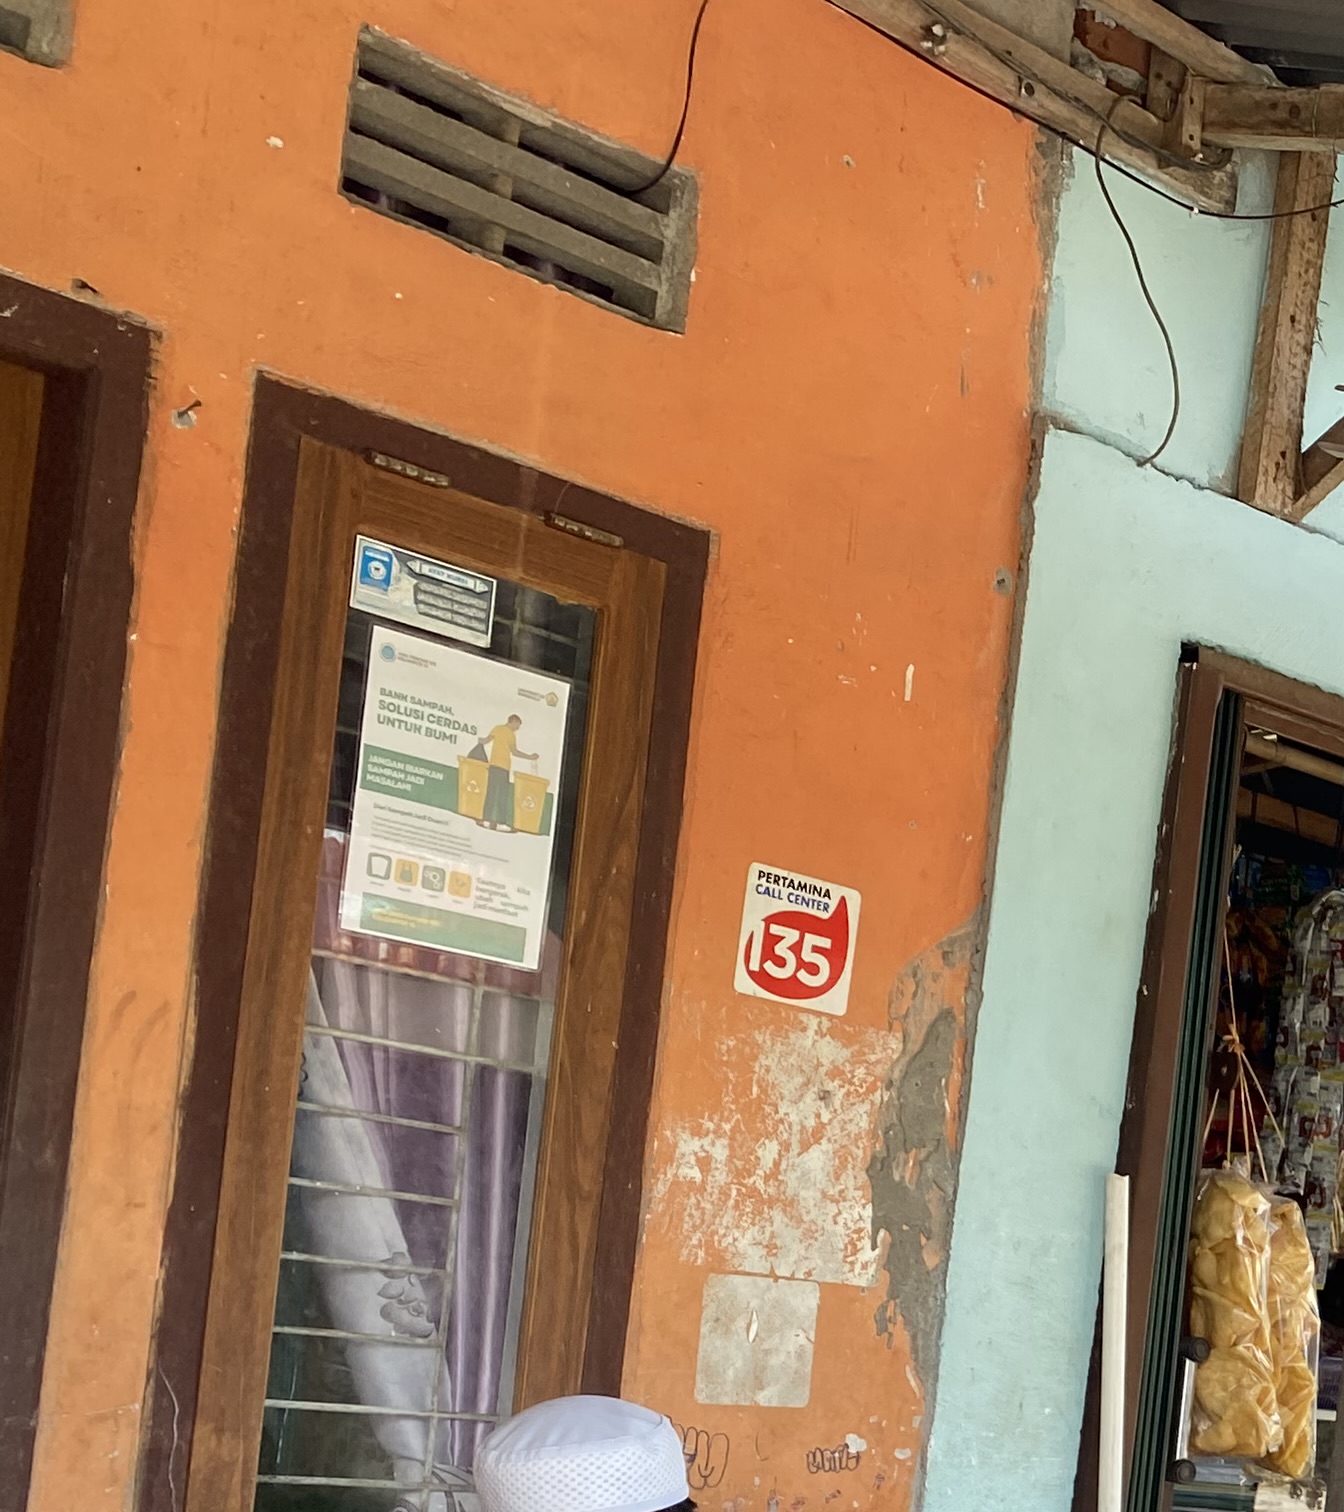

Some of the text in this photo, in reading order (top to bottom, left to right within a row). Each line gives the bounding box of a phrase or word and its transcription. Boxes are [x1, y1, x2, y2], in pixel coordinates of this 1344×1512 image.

[379, 687, 408, 703] BANK
[377, 713, 457, 745] UNTUK BUMI
[378, 700, 478, 736] SOLUSI CERDAS
[367, 764, 405, 781] SAMPAH
[368, 755, 405, 770] JANGAN
[755, 883, 830, 914] CALL CENTER
[757, 870, 832, 900] PERTAMINA
[748, 920, 832, 988] 135
